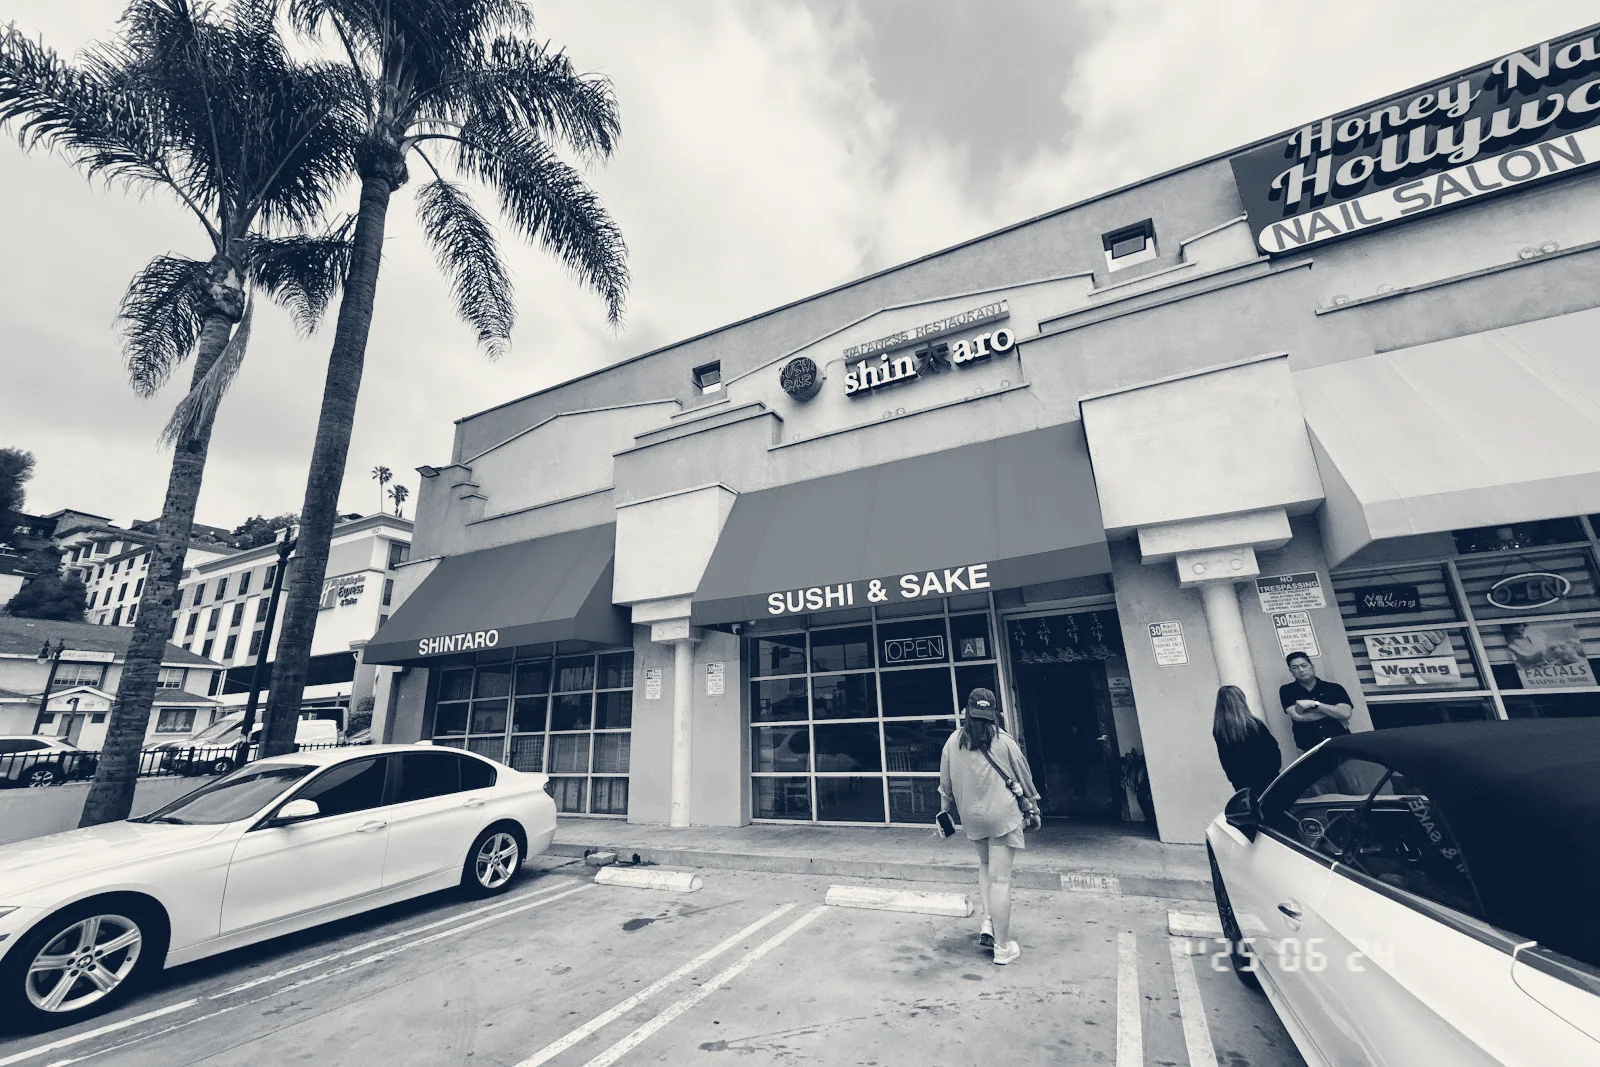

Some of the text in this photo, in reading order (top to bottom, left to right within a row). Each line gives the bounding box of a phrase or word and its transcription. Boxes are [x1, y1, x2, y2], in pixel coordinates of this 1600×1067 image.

[1288, 79, 1481, 160] Honey
[1272, 135, 1586, 251] NAIL SALON
[843, 301, 1002, 359] JAPANESE RESTAURANT
[767, 563, 991, 615] SUSHI & SAKE
[1259, 581, 1319, 592] TRESPASSING
[1494, 578, 1560, 604] OEN
[1274, 616, 1288, 627] 30
[1150, 626, 1161, 635] 30
[419, 629, 499, 655] SHINTARO
[1371, 634, 1427, 647] NAIL
[887, 638, 942, 660] OPEN
[964, 642, 975, 654] A
[1378, 645, 1426, 657] SPA
[1381, 662, 1450, 675] Waxing
[1524, 664, 1587, 677] FACIALS
